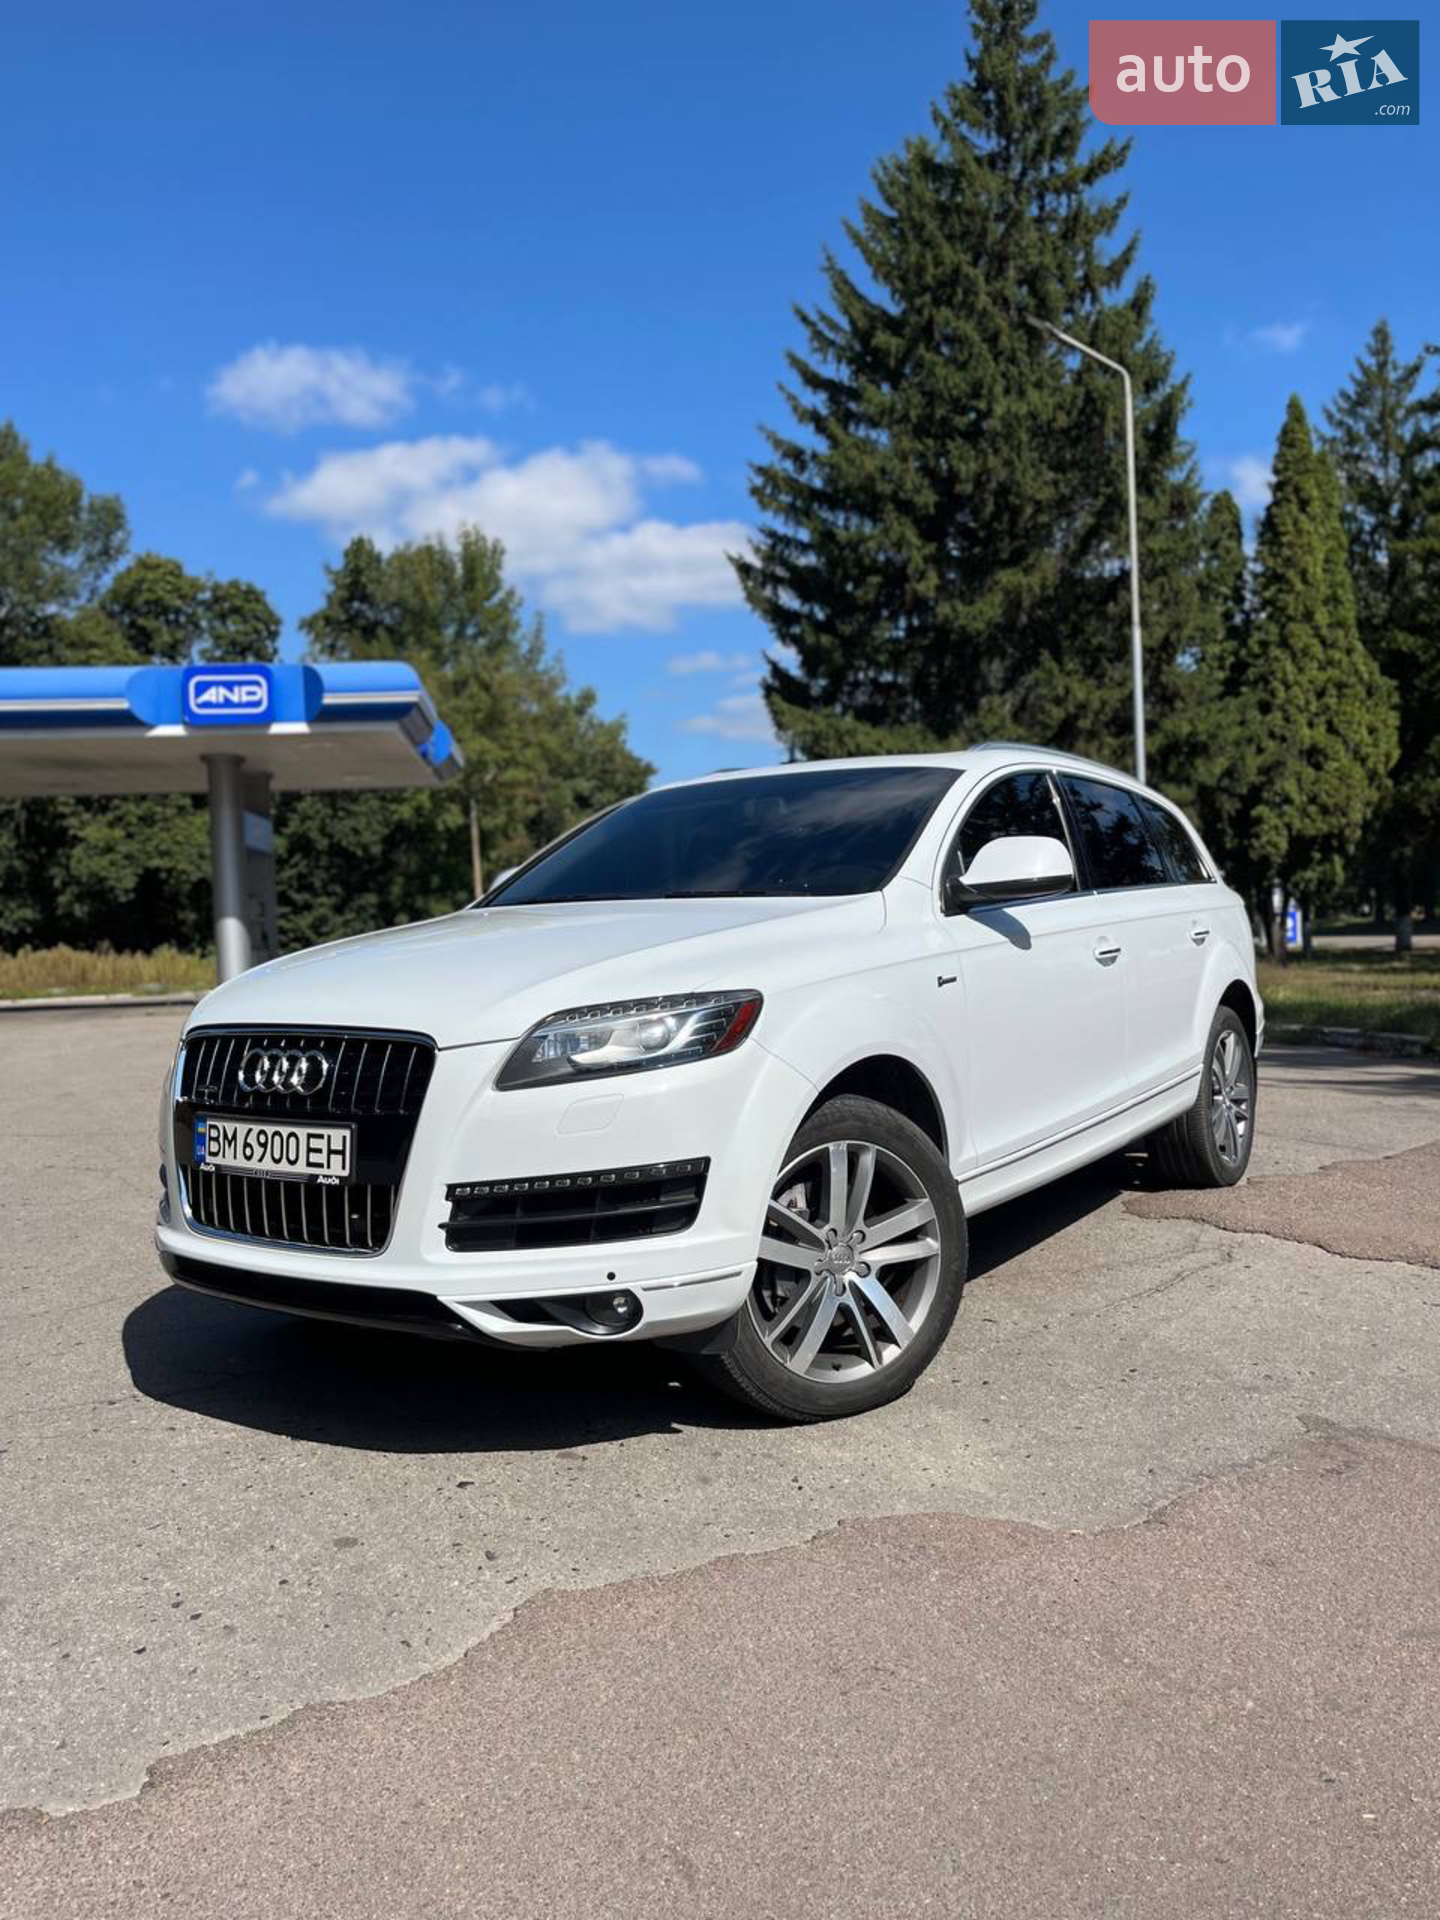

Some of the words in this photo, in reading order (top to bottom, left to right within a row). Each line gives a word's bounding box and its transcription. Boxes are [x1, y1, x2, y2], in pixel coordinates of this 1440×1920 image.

[196, 685, 264, 704] ANP
[208, 1124, 238, 1160] BM
[242, 1127, 300, 1166] 6900
[306, 1132, 347, 1171] EH
